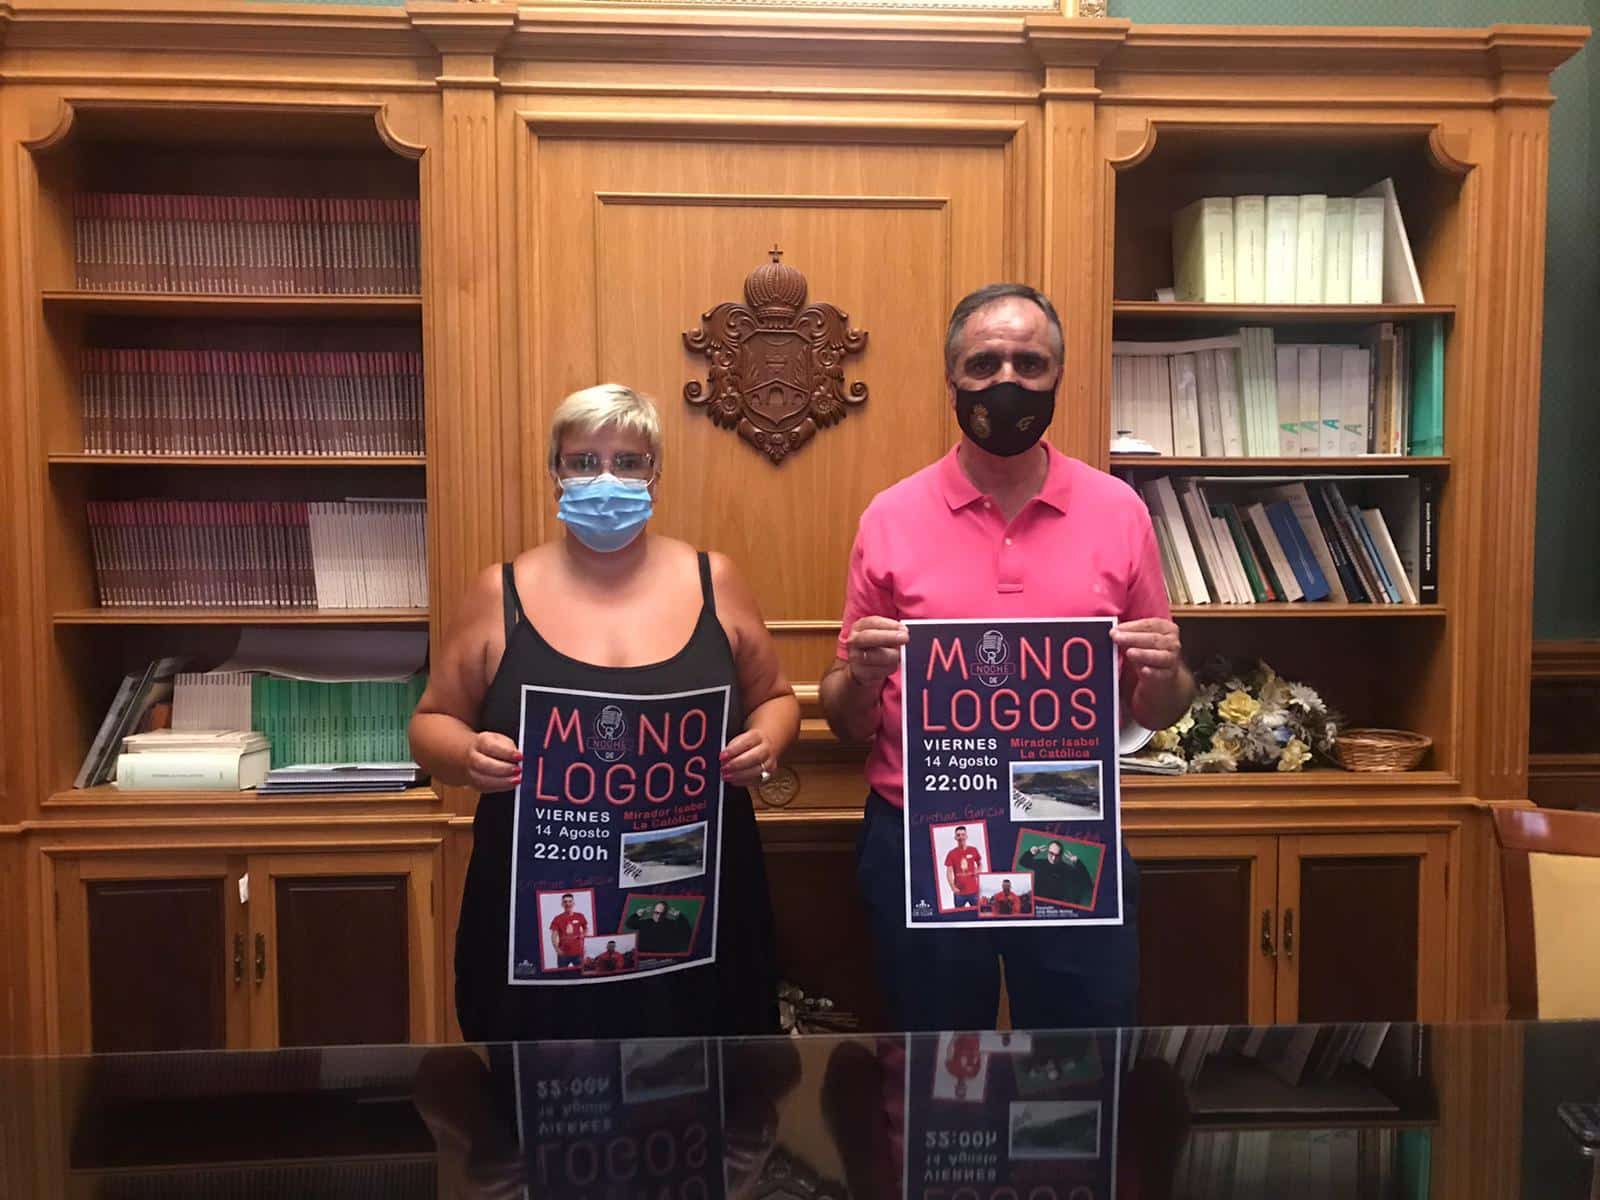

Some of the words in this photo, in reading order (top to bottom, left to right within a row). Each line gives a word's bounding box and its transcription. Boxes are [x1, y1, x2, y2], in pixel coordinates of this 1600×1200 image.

[976, 665, 1009, 673] NOCHE
[921, 688, 1097, 731] LOGOS
[923, 738, 998, 751] VIERNES
[1011, 737, 1056, 747] Mirador
[1062, 736, 1099, 747] Isabel
[1020, 748, 1036, 759] La
[925, 755, 941, 767] 14
[948, 755, 998, 769] Agosto
[535, 756, 707, 805] LOGOS
[925, 774, 998, 791] 22:00h
[535, 807, 610, 823] VIERNES
[623, 807, 669, 821] Mirador
[535, 824, 552, 836] 14
[559, 826, 610, 840] Agosto
[632, 820, 649, 831] La
[534, 843, 608, 861] 22:00h
